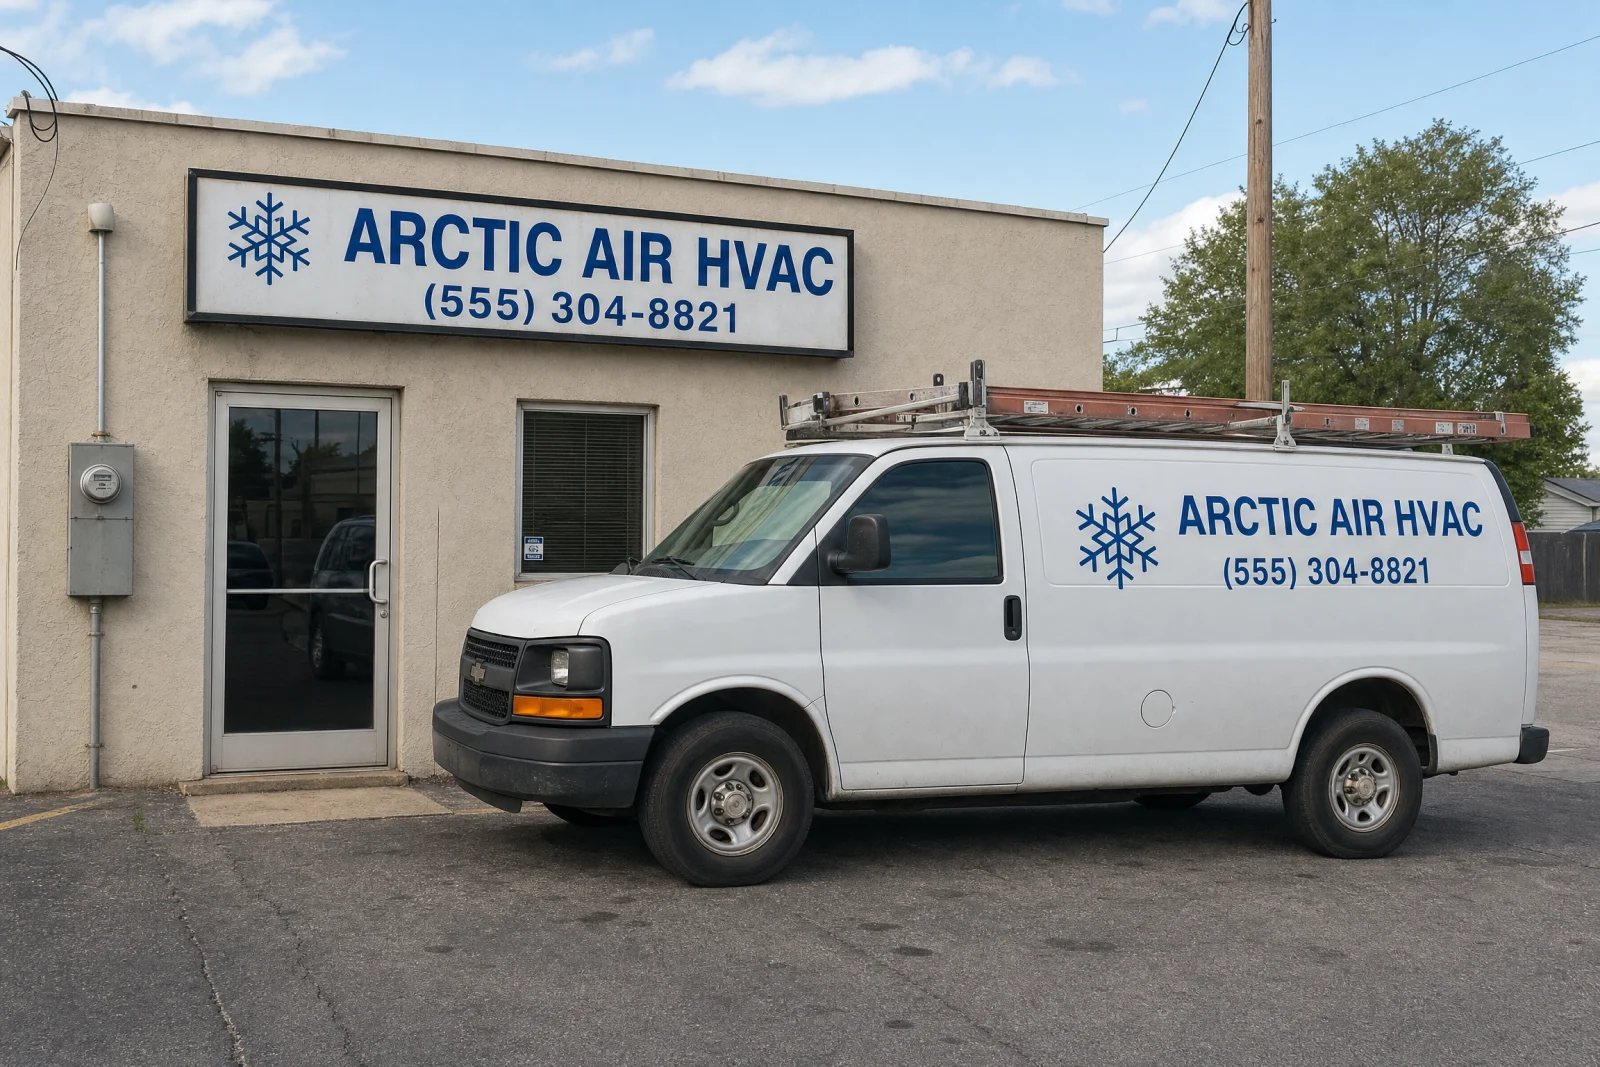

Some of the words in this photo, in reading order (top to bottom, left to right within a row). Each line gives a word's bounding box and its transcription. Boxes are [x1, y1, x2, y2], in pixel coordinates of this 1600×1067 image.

[343, 207, 562, 277] ARCTIC
[582, 227, 672, 284] AIR
[697, 237, 834, 297] HVAC
[424, 283, 535, 325] (555)
[551, 291, 736, 333] 304-8821
[1178, 495, 1318, 537] ARCTIC
[1330, 498, 1387, 536] AIR
[1394, 499, 1483, 537] HVAC
[1223, 556, 1297, 591] (555)
[1307, 556, 1429, 585] 304-8821
